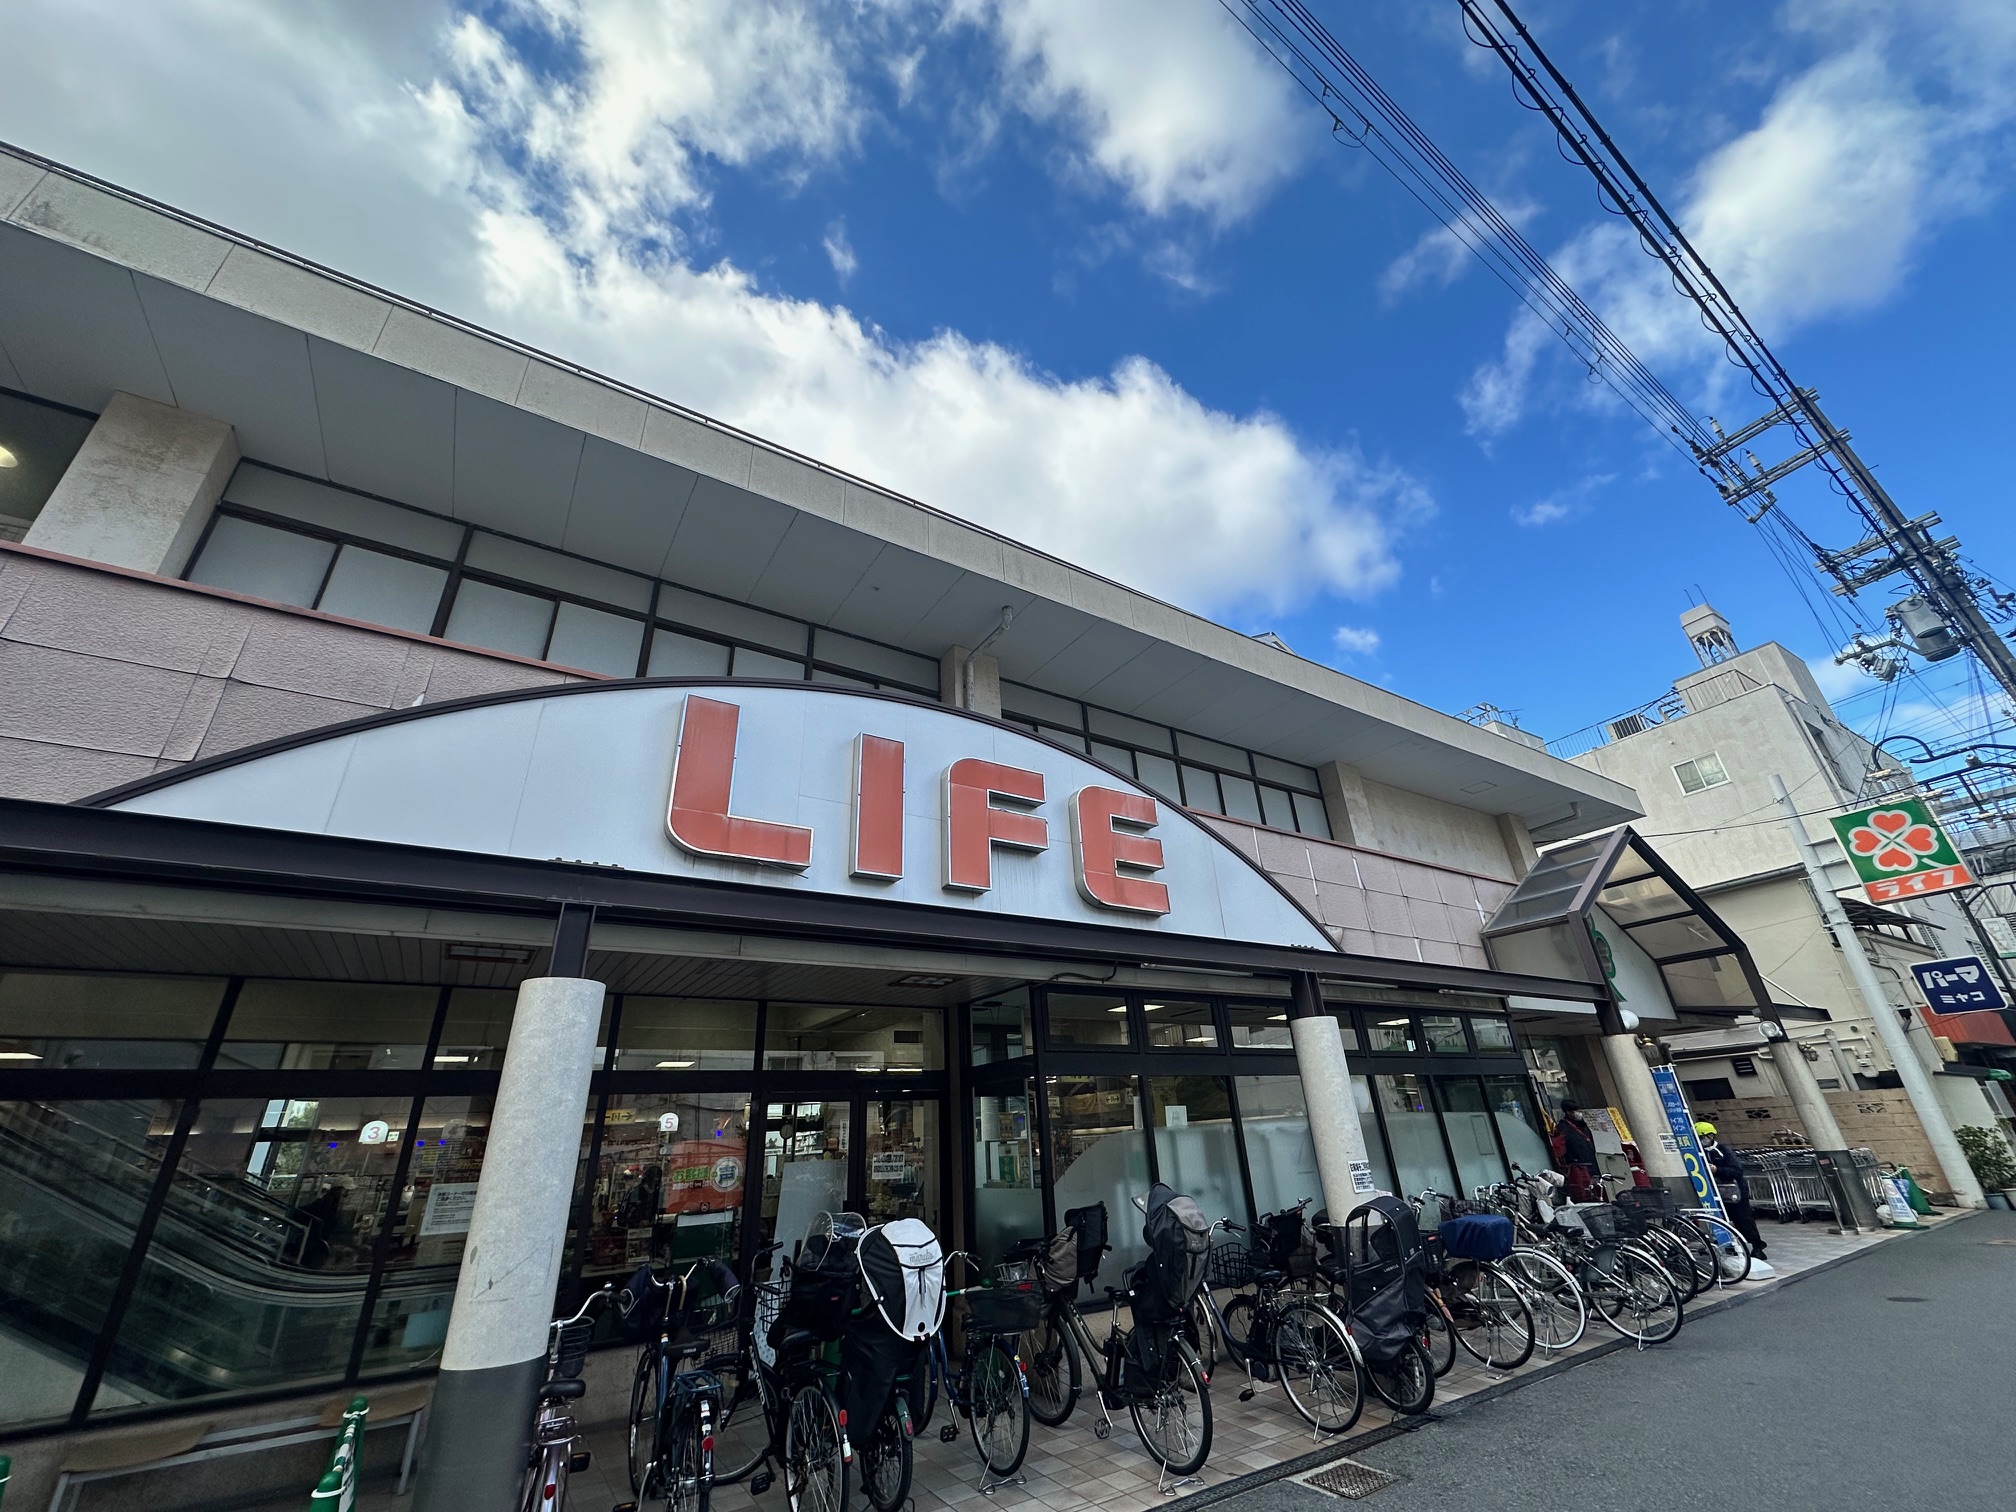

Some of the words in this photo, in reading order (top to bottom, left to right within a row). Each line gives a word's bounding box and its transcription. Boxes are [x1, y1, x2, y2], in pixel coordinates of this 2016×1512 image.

[665, 693, 1171, 916] LIFE
[1876, 869, 1956, 896] ライフ
[1922, 964, 1980, 989] パーマ
[1939, 991, 1986, 1004] ミヤコ
[367, 1126, 381, 1140] 3
[664, 1117, 674, 1129] 5
[1683, 1152, 1708, 1198] 3
